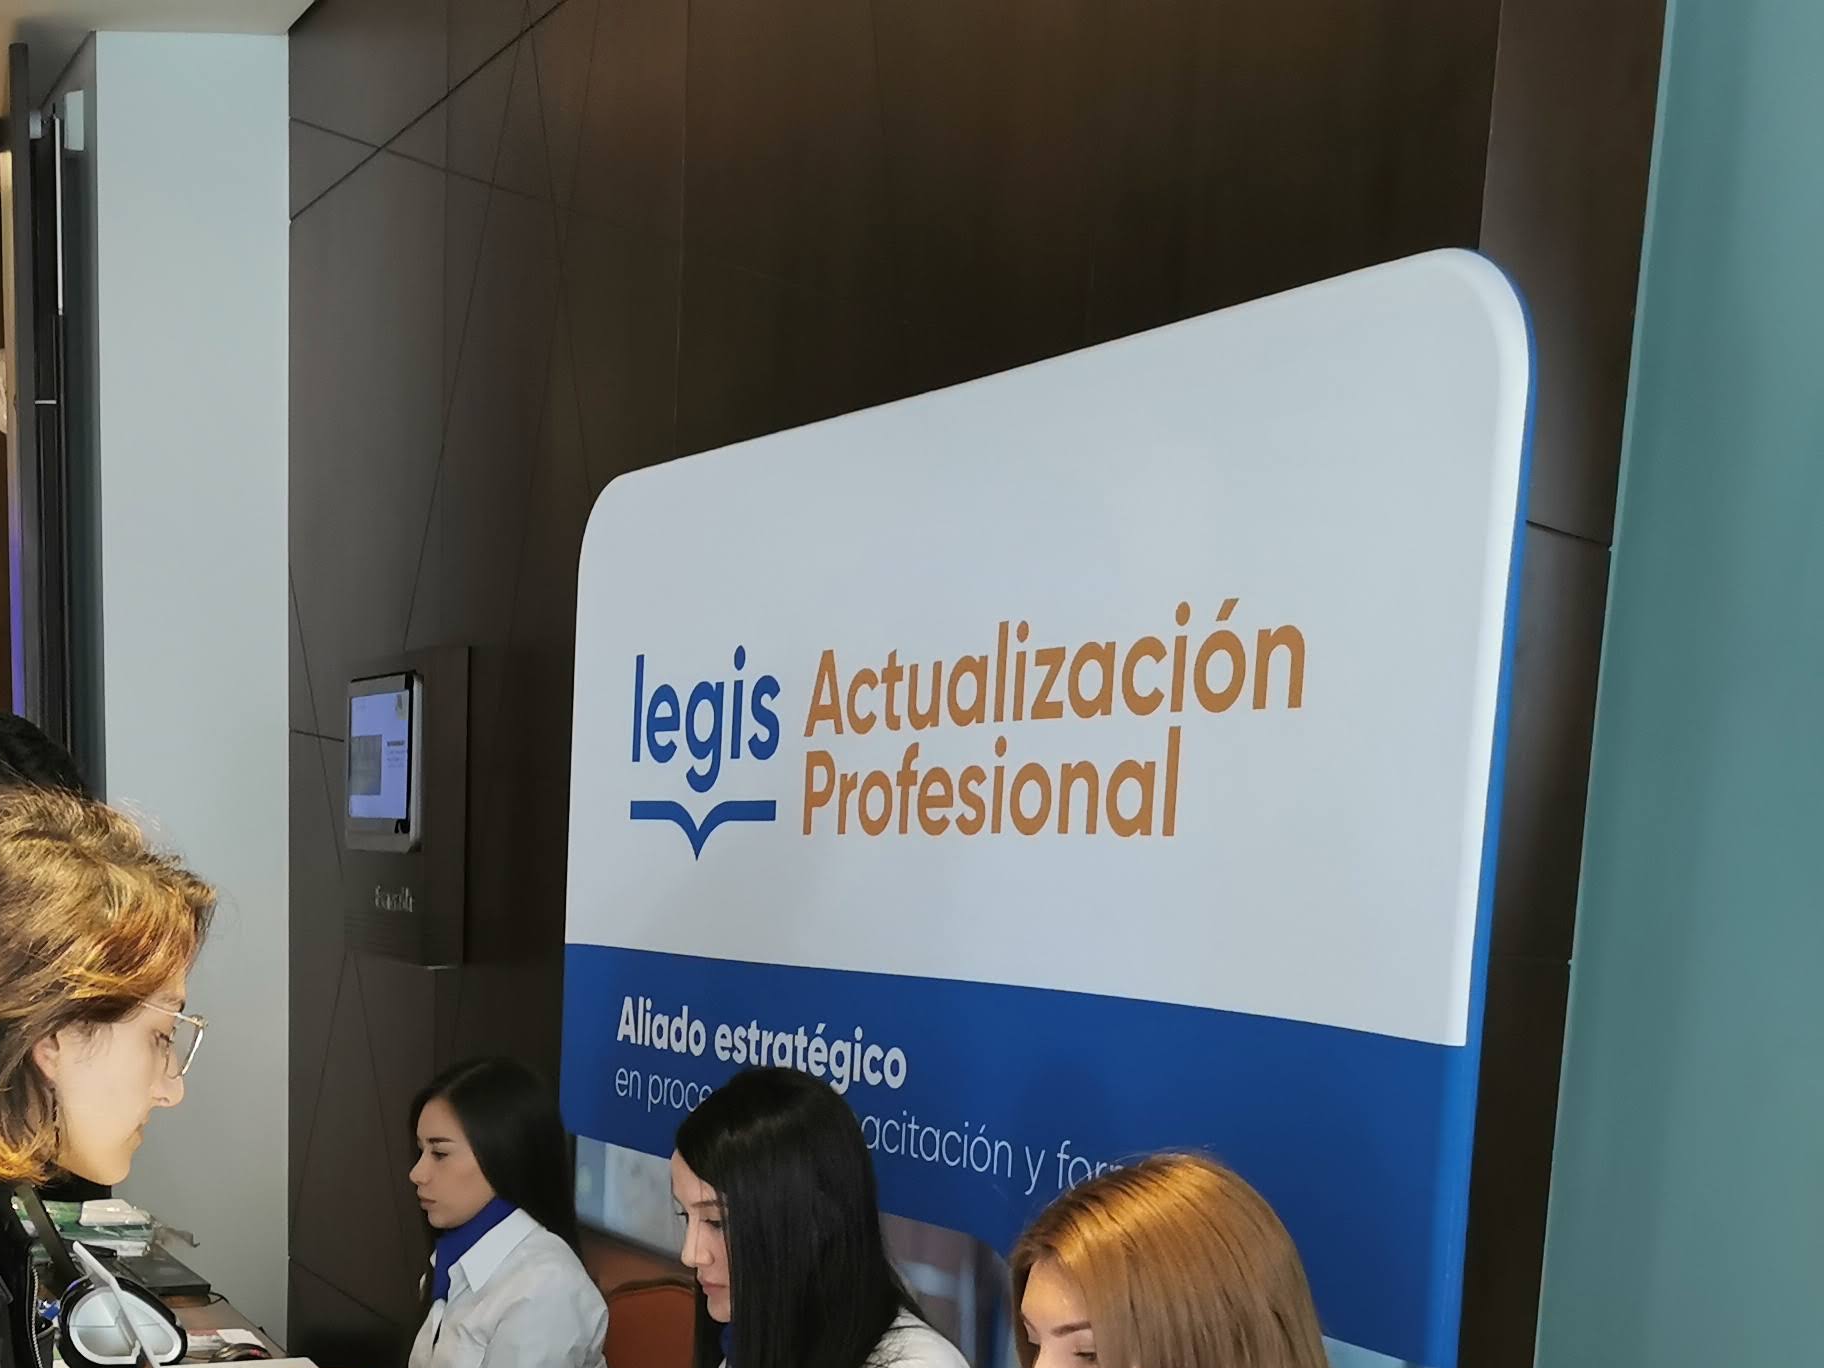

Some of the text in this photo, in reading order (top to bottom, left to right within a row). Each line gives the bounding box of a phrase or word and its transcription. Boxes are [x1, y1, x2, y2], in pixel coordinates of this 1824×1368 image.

[631, 644, 781, 793] legis
[804, 598, 1306, 737] Actualización
[803, 726, 1182, 837] Profesional
[617, 995, 907, 1096] Aliado estratégico
[615, 1067, 1124, 1196] en proce acitación y for
